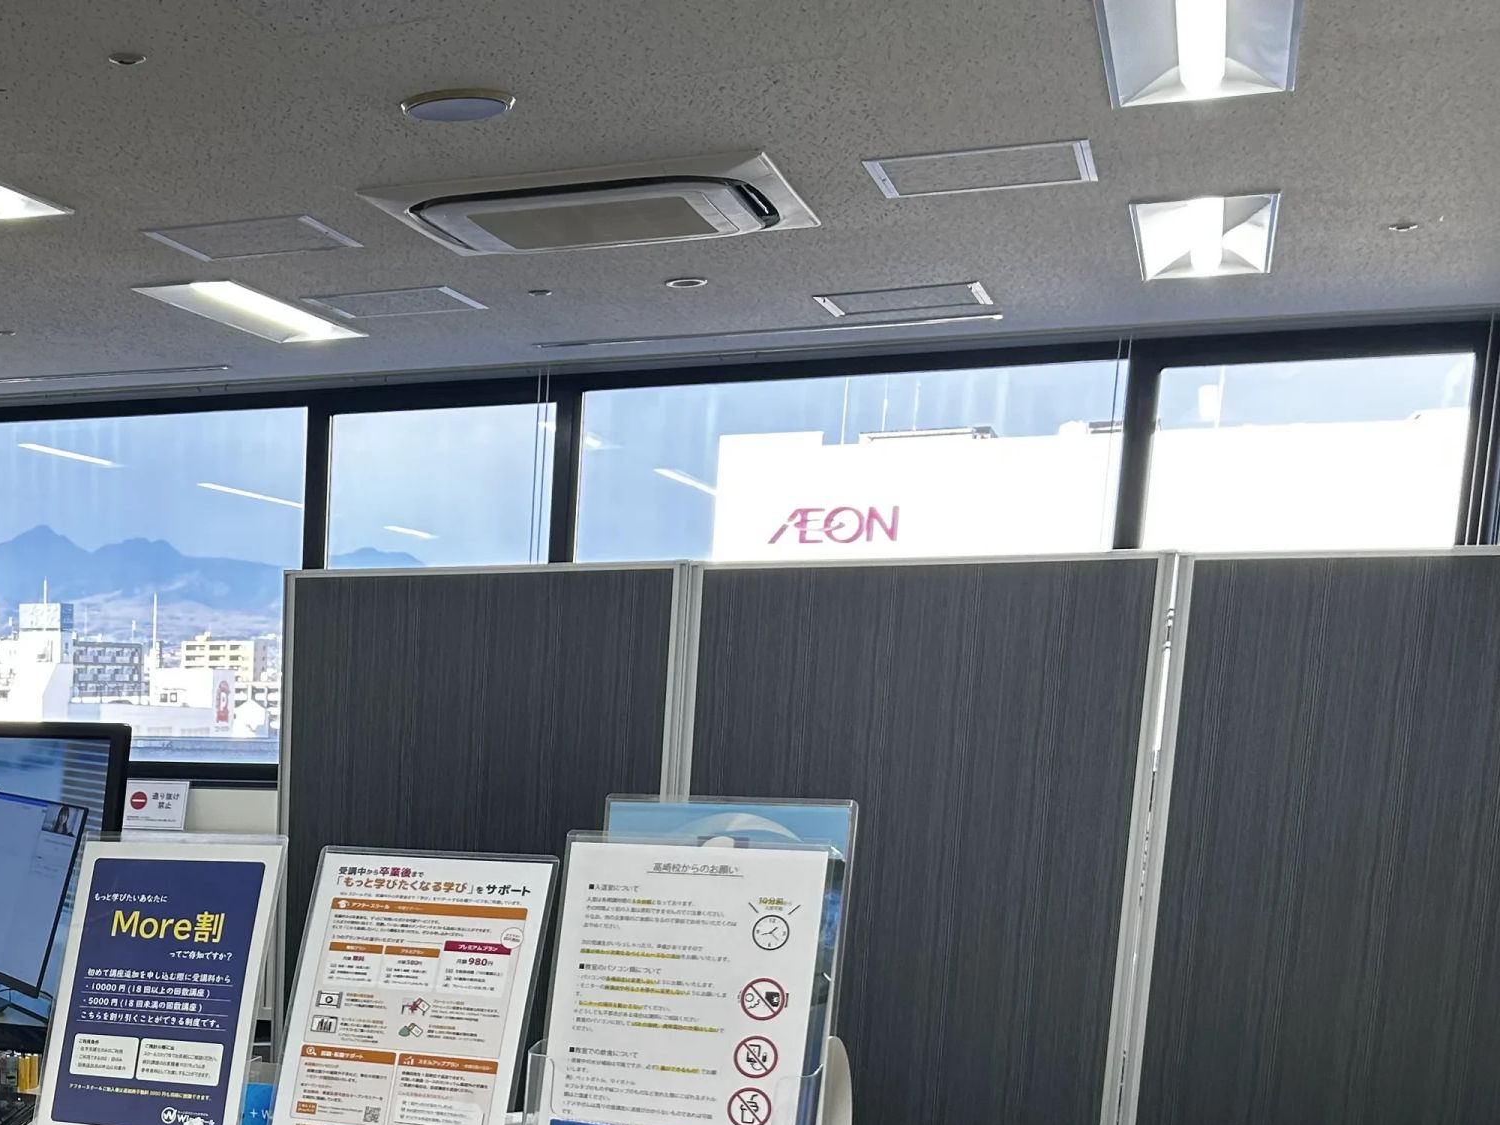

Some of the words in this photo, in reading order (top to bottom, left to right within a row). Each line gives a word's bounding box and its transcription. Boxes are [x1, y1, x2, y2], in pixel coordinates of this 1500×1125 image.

[158, 801, 172, 809] 禁止
[338, 866, 424, 878] 受講中から卒業後まで
[652, 862, 740, 875] 高崎校からのお願い
[94, 892, 168, 903] もっと学びたいあなたに
[110, 909, 226, 943] More割
